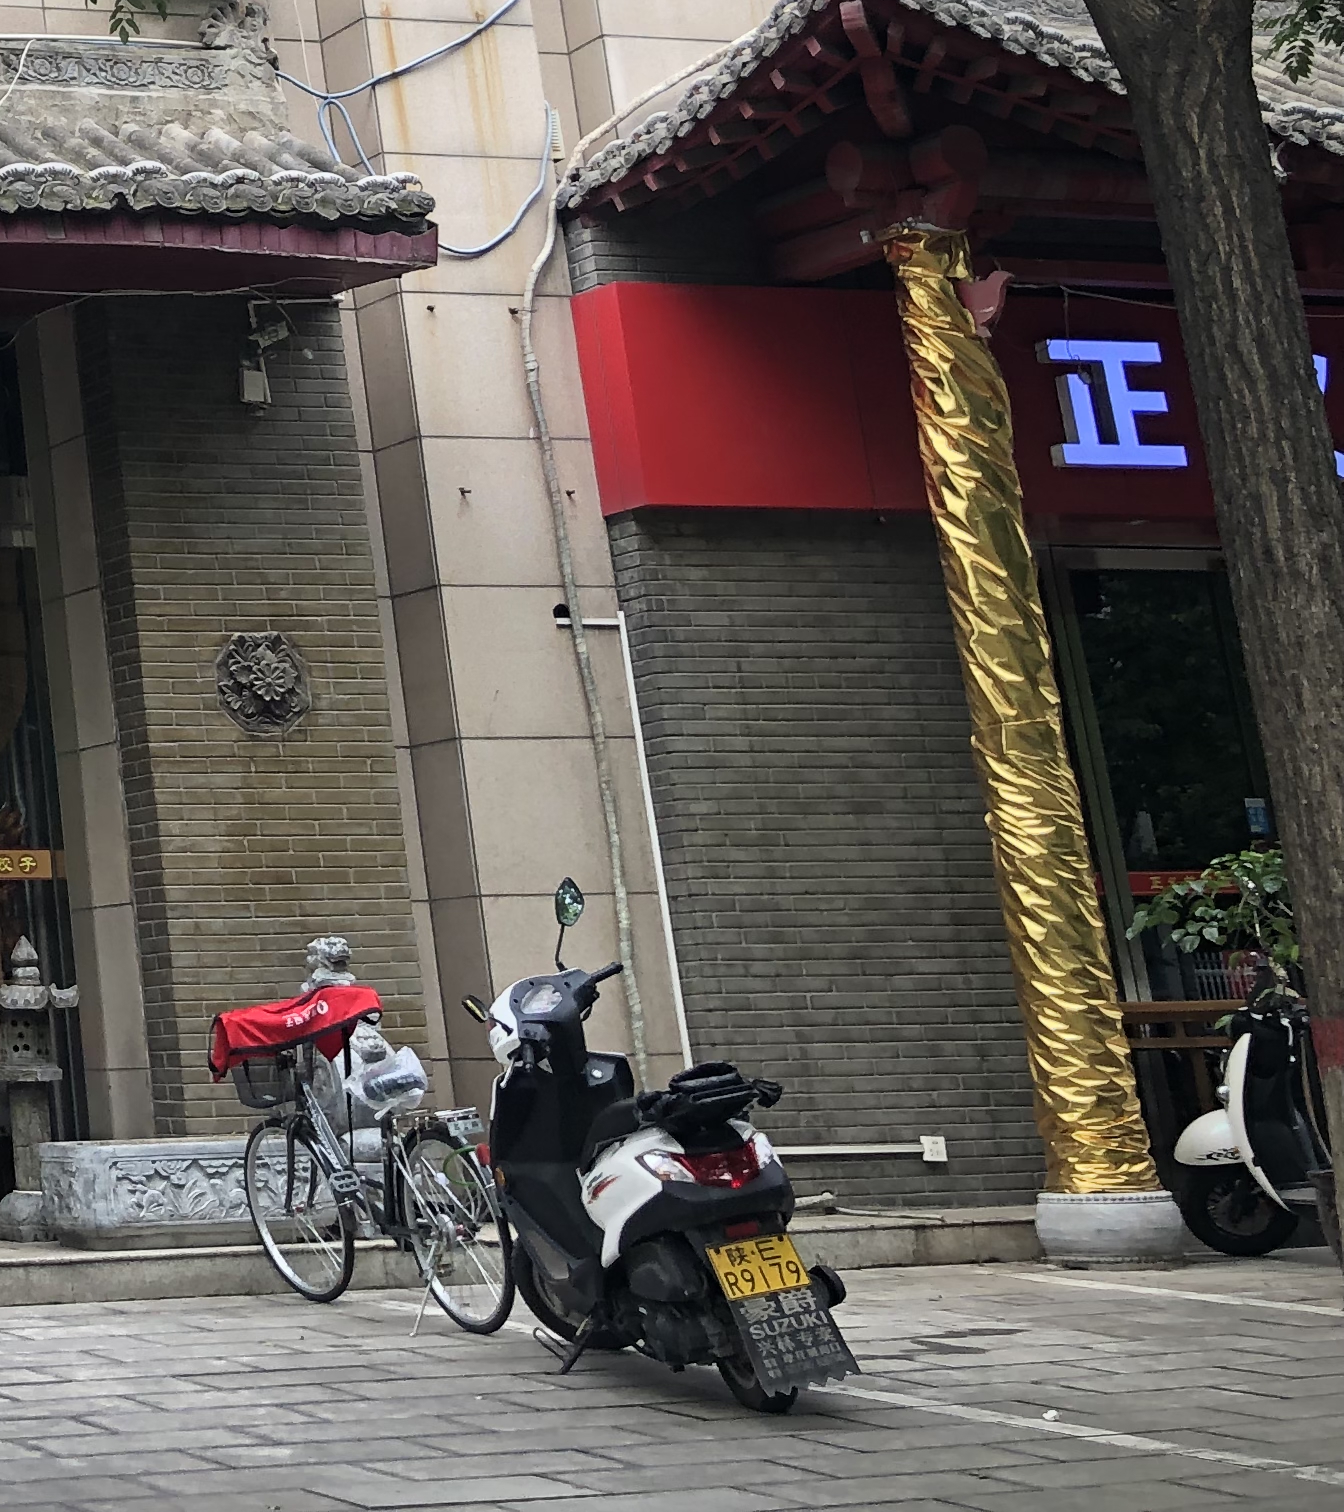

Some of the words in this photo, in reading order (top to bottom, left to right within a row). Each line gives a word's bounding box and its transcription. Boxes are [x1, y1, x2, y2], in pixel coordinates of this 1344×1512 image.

[724, 1260, 801, 1297] R9179
[739, 1288, 817, 1324] 豪爵
[749, 1310, 830, 1340] SUZUKI
